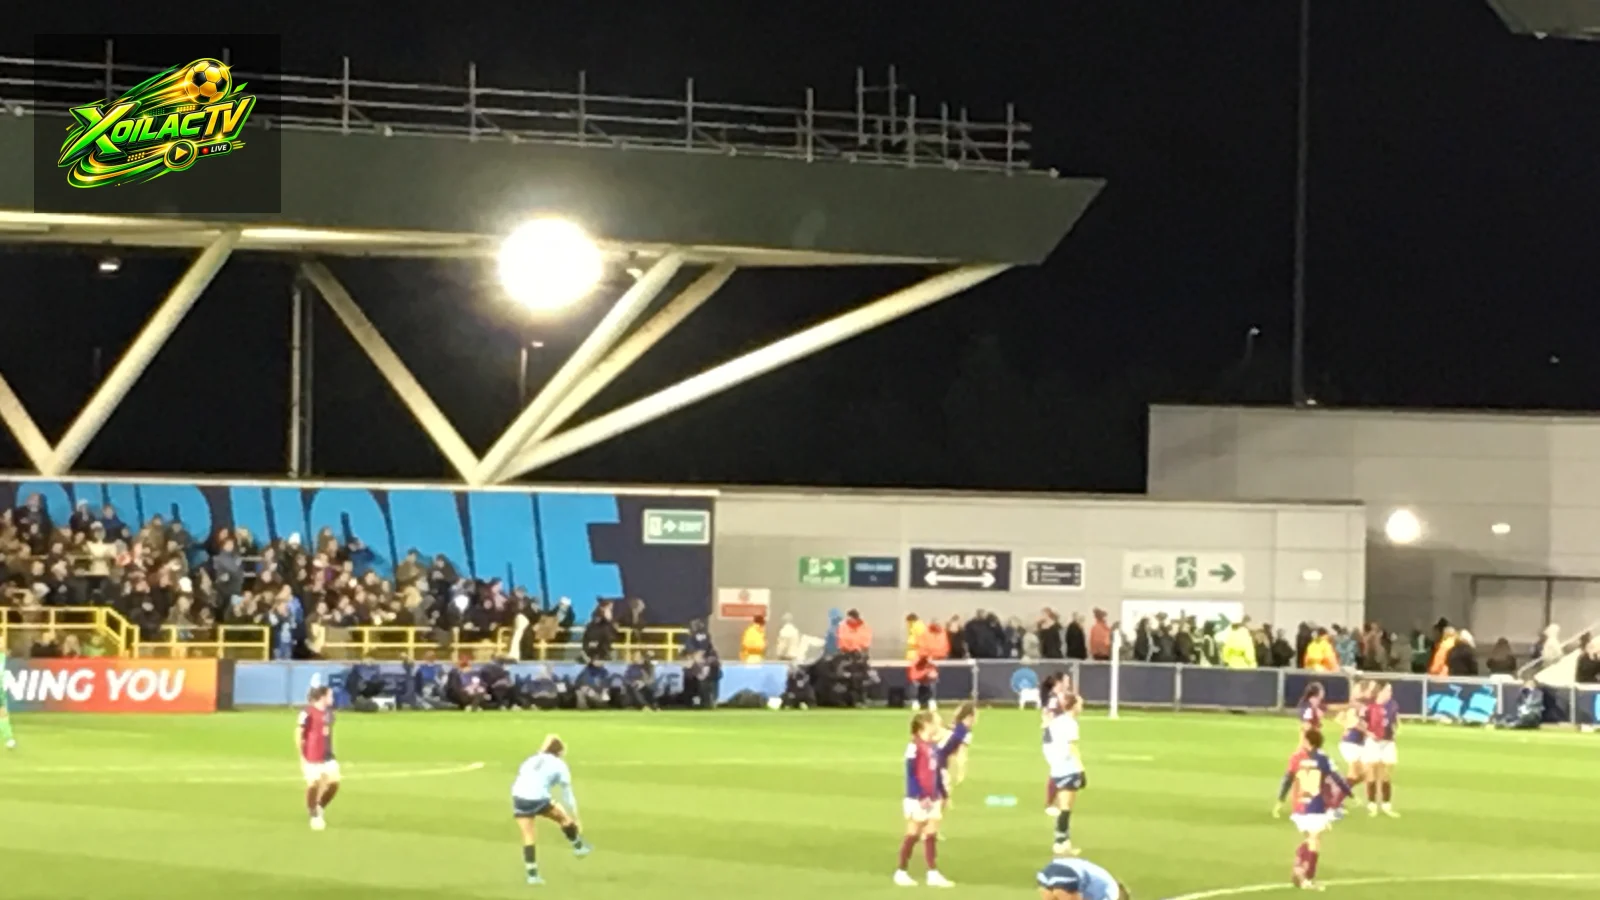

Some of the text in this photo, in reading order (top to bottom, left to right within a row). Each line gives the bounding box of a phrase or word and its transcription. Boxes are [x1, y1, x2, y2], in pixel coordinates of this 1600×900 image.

[924, 554, 997, 570] TOILETS
[1131, 563, 1164, 580] Exit
[106, 669, 185, 701] YOU
